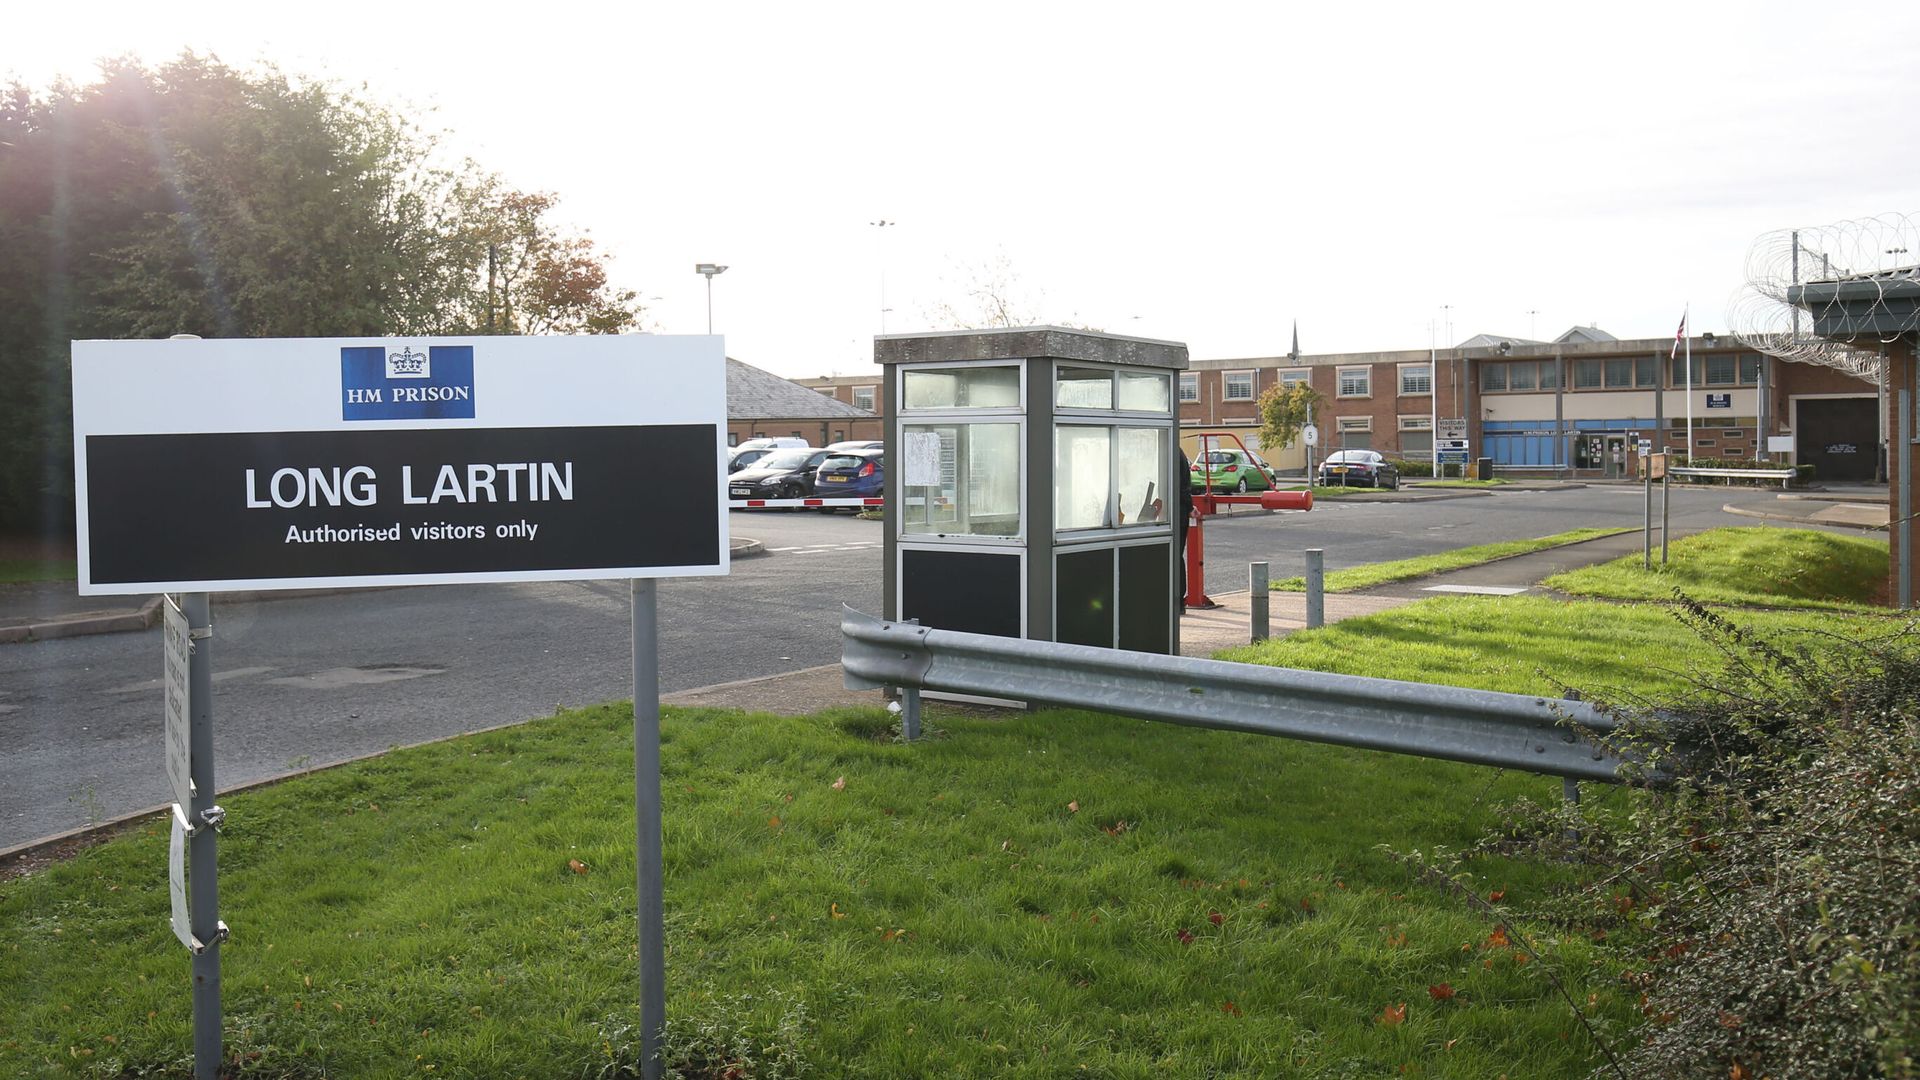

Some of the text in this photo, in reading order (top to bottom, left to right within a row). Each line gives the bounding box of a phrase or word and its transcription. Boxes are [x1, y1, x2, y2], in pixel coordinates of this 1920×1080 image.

[346, 386, 470, 404] HM PRISON
[245, 462, 573, 509] LONG LARTIN
[284, 519, 539, 544] Authorised visitors only
